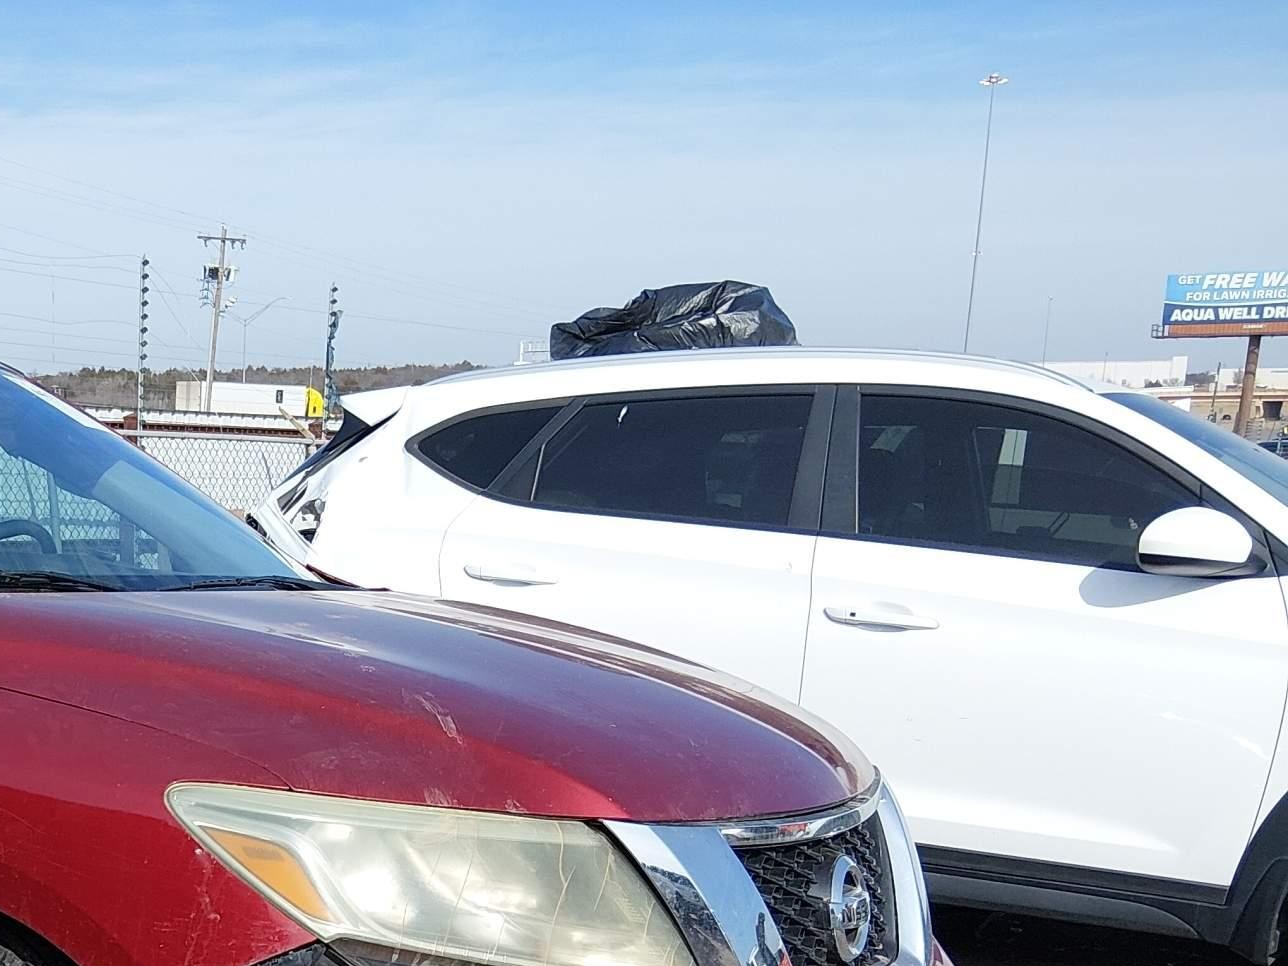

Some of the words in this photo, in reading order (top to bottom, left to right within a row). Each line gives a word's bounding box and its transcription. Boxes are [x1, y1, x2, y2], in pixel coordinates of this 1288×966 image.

[1178, 275, 1202, 285] GET
[1202, 272, 1258, 290] FREE
[1185, 291, 1210, 301] FOR
[1213, 290, 1249, 300] LAWN
[1253, 289, 1288, 299] IRRIG
[1170, 309, 1215, 321] AQUA
[1218, 306, 1260, 320] WELL
